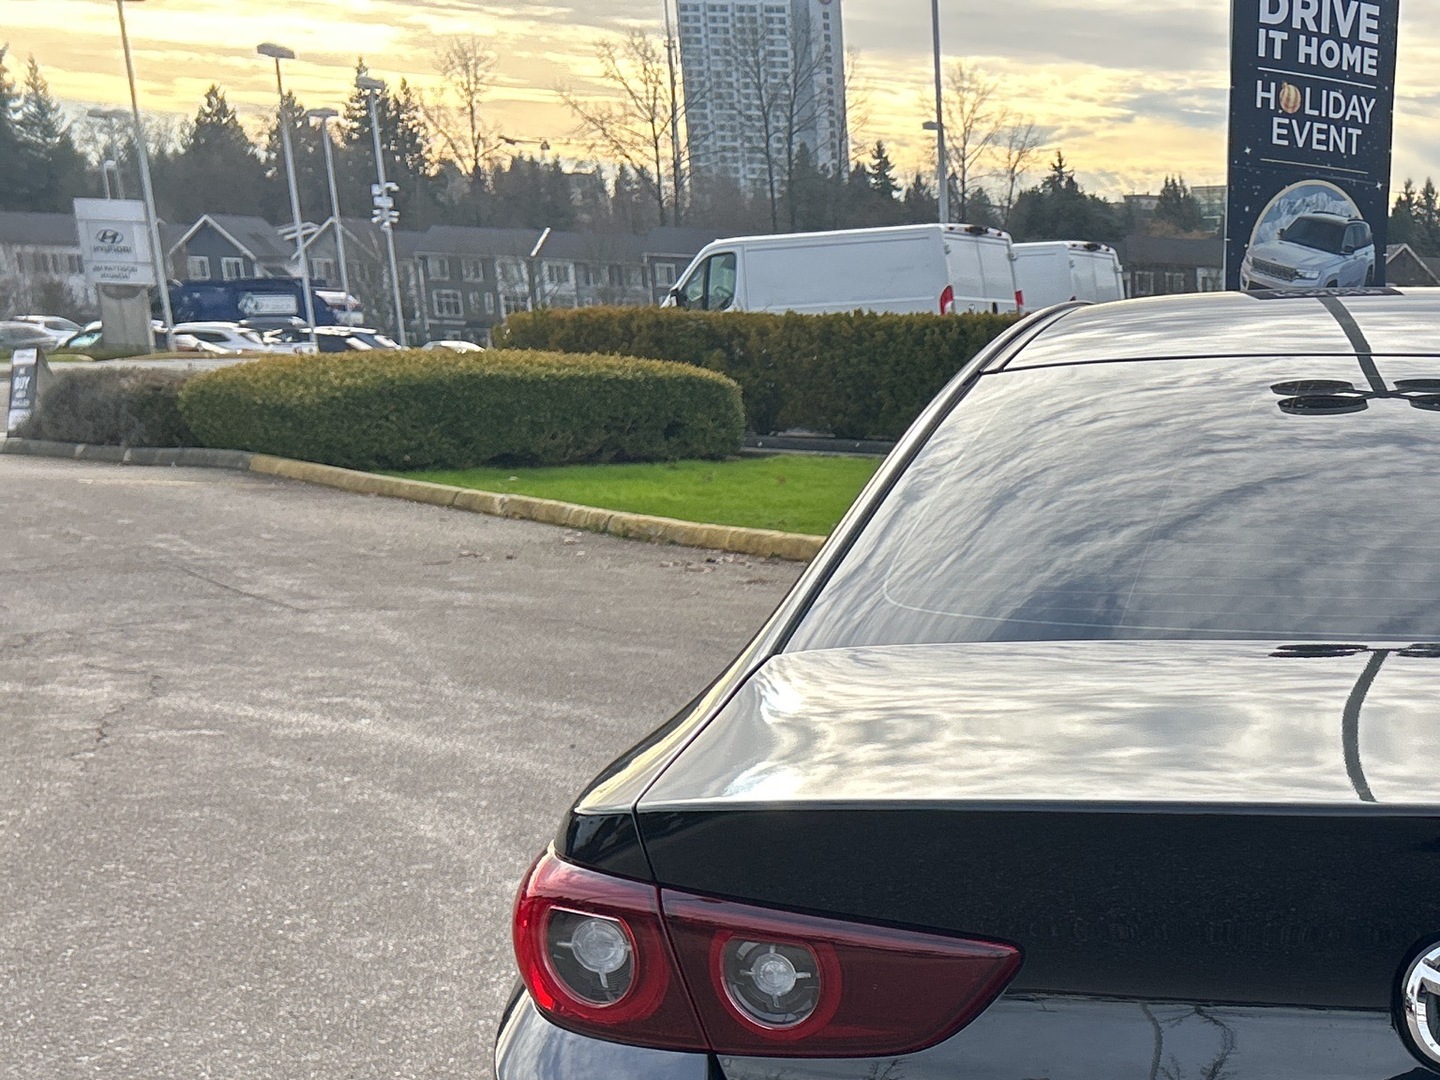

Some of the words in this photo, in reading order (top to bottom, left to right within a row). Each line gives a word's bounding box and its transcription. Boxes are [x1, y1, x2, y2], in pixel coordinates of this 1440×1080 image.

[1258, 0, 1381, 44] DRIVE
[1257, 28, 1289, 60] IT
[1297, 34, 1379, 77] HOME
[1255, 79, 1376, 125] HOLIDAY
[1271, 117, 1363, 155] EVENT
